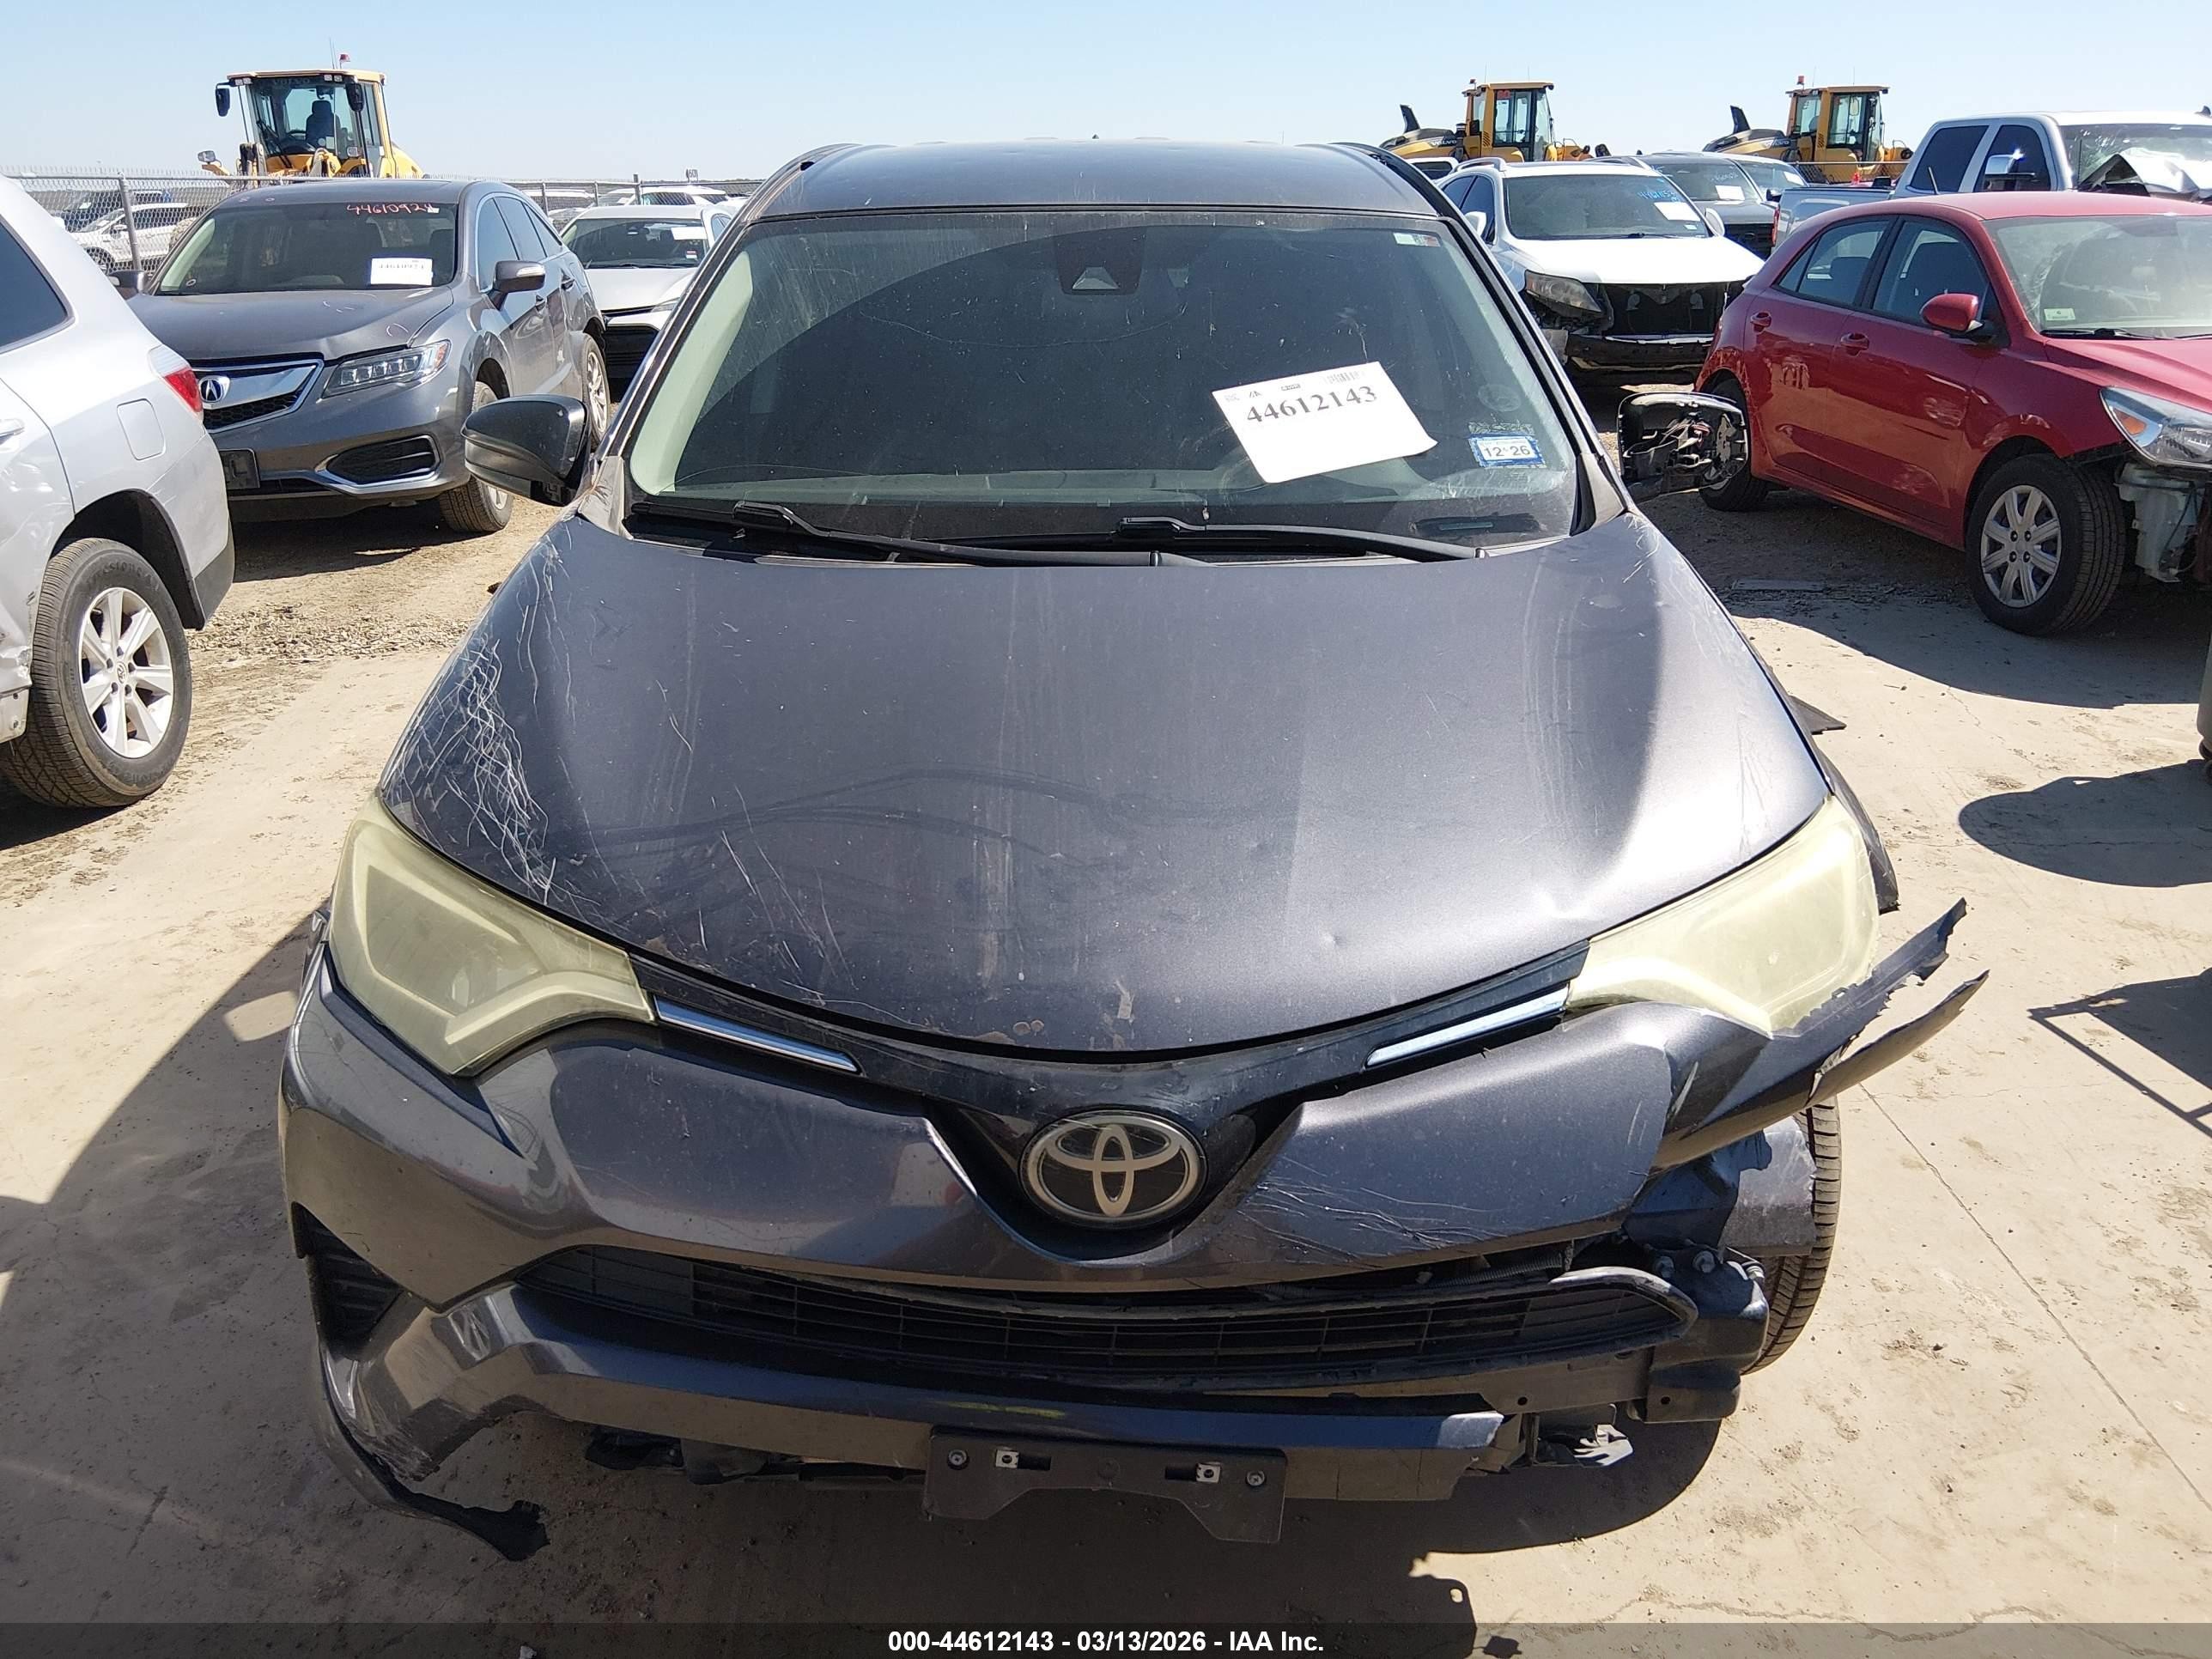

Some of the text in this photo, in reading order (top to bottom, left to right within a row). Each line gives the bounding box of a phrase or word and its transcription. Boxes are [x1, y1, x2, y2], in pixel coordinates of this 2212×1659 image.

[1247, 386, 1377, 422] 44612143
[1484, 445, 1530, 457] 12 26
